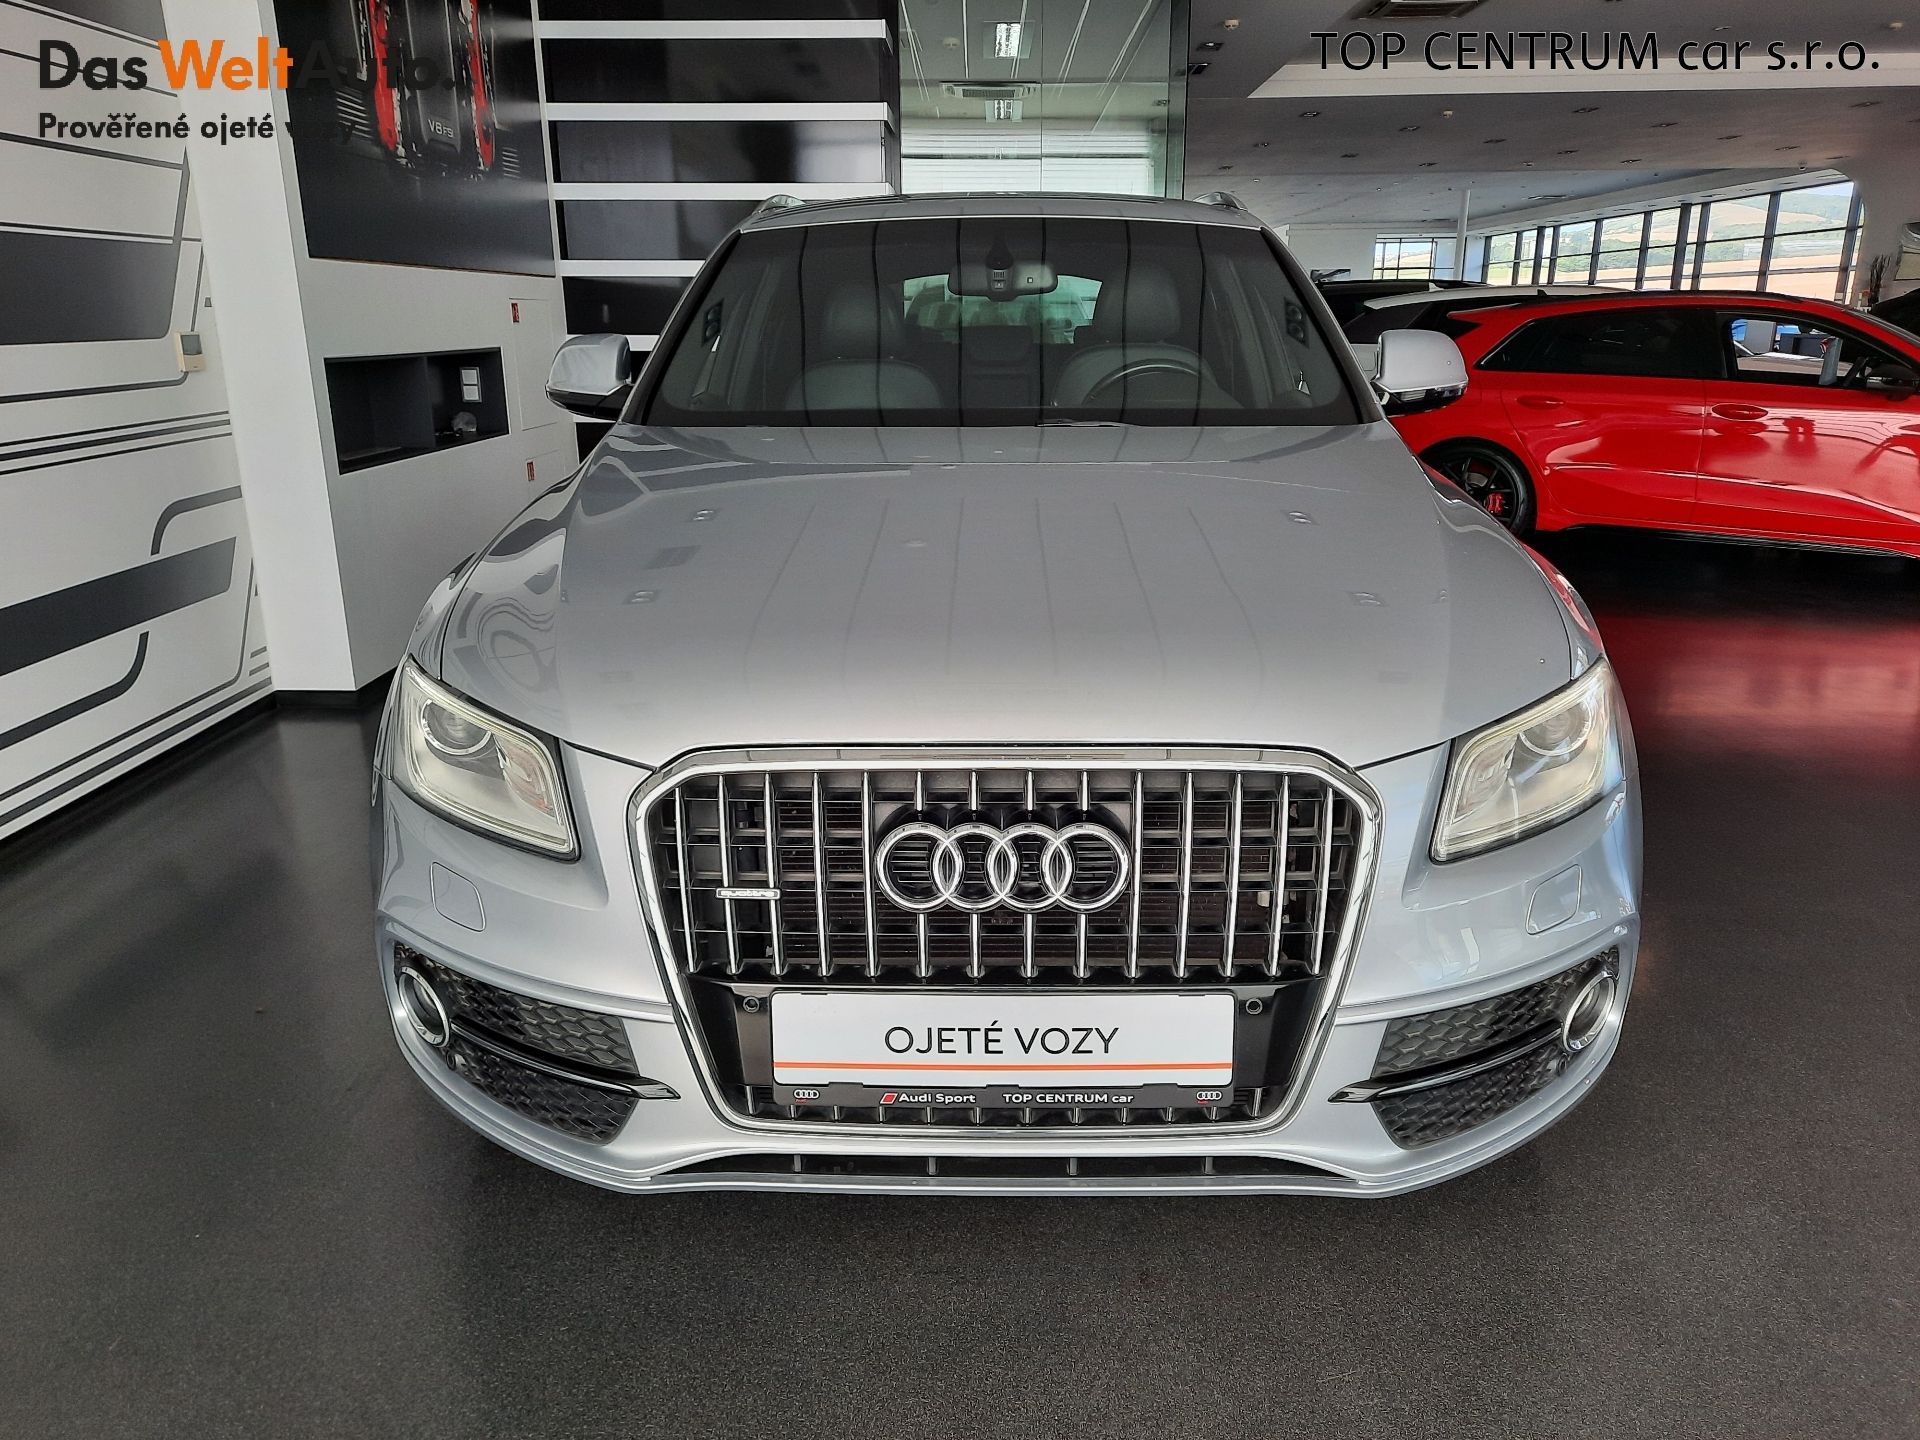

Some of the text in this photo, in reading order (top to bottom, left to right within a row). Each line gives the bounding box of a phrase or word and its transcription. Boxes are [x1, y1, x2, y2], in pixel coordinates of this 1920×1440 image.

[884, 1020, 1119, 1054] OJETÉ VOZY
[899, 1093, 976, 1104] Audi Sport
[1003, 1094, 1134, 1103] TOP CENTRUM car
